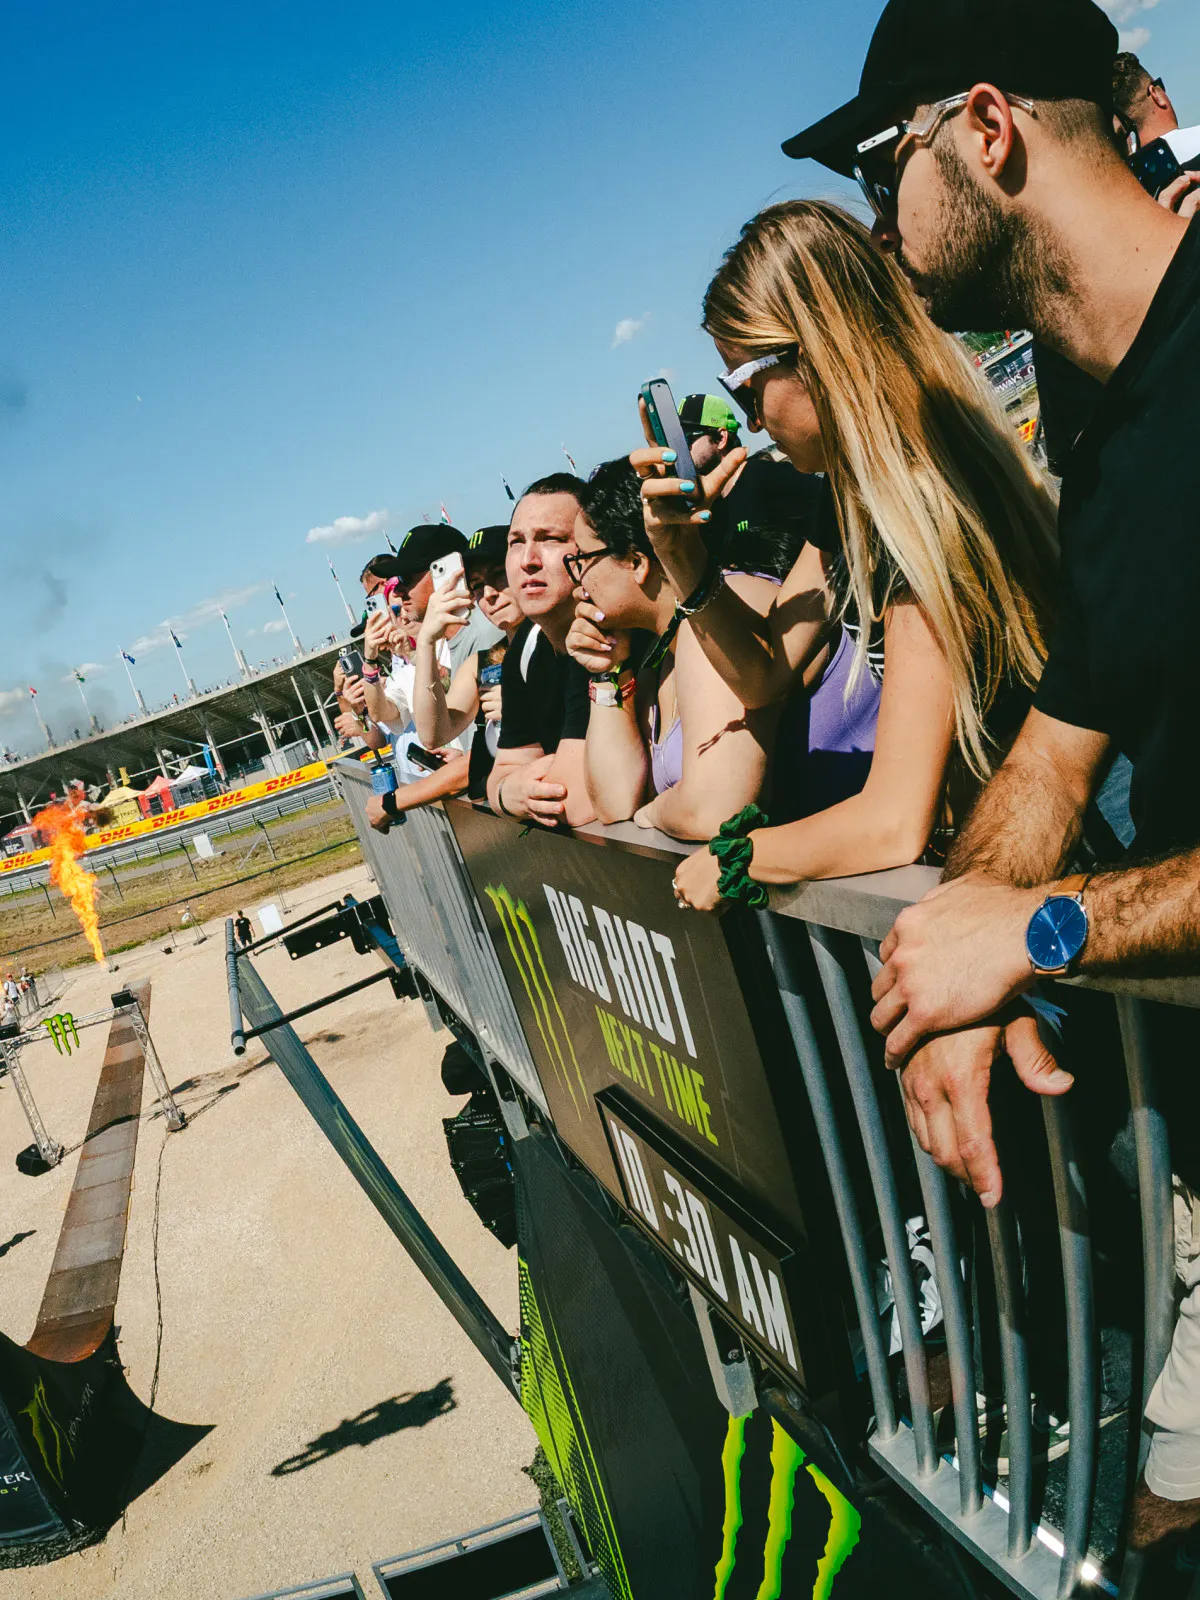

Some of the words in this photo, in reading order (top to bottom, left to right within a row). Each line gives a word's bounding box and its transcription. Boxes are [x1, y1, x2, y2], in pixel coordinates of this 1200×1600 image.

[265, 771, 306, 792] DHL
[207, 792, 246, 811] DHL
[151, 810, 190, 829] DHL
[100, 827, 135, 843] DHL
[3, 854, 34, 870] DHL
[542, 883, 612, 1004] RIG
[592, 905, 697, 1059] RIOT
[595, 1004, 655, 1097] NEXT
[648, 1041, 718, 1147] TIME
[729, 1234, 798, 1371] AM
